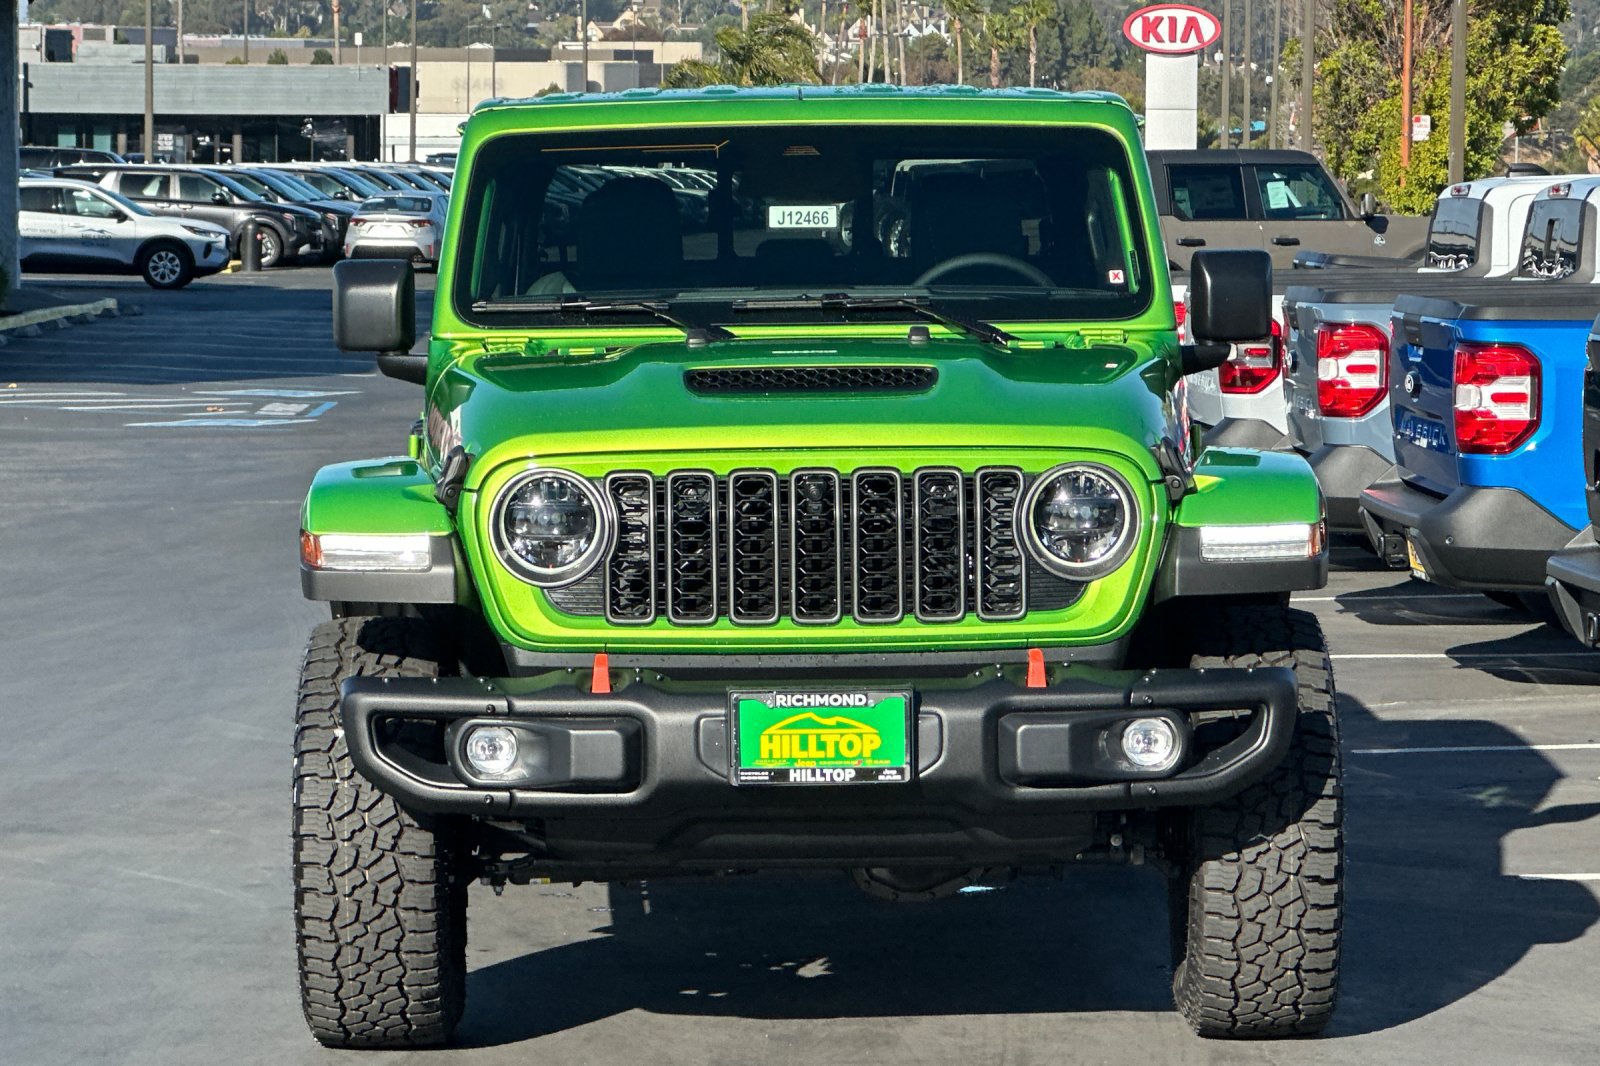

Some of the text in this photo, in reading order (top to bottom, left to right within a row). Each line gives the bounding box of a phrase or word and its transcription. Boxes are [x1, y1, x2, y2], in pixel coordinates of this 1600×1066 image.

[1141, 16, 1205, 43] KIA
[777, 210, 829, 225] J12466
[775, 694, 867, 707] RICHMOND
[759, 734, 882, 759] HILLTOP
[789, 768, 856, 782] HILLTOP
